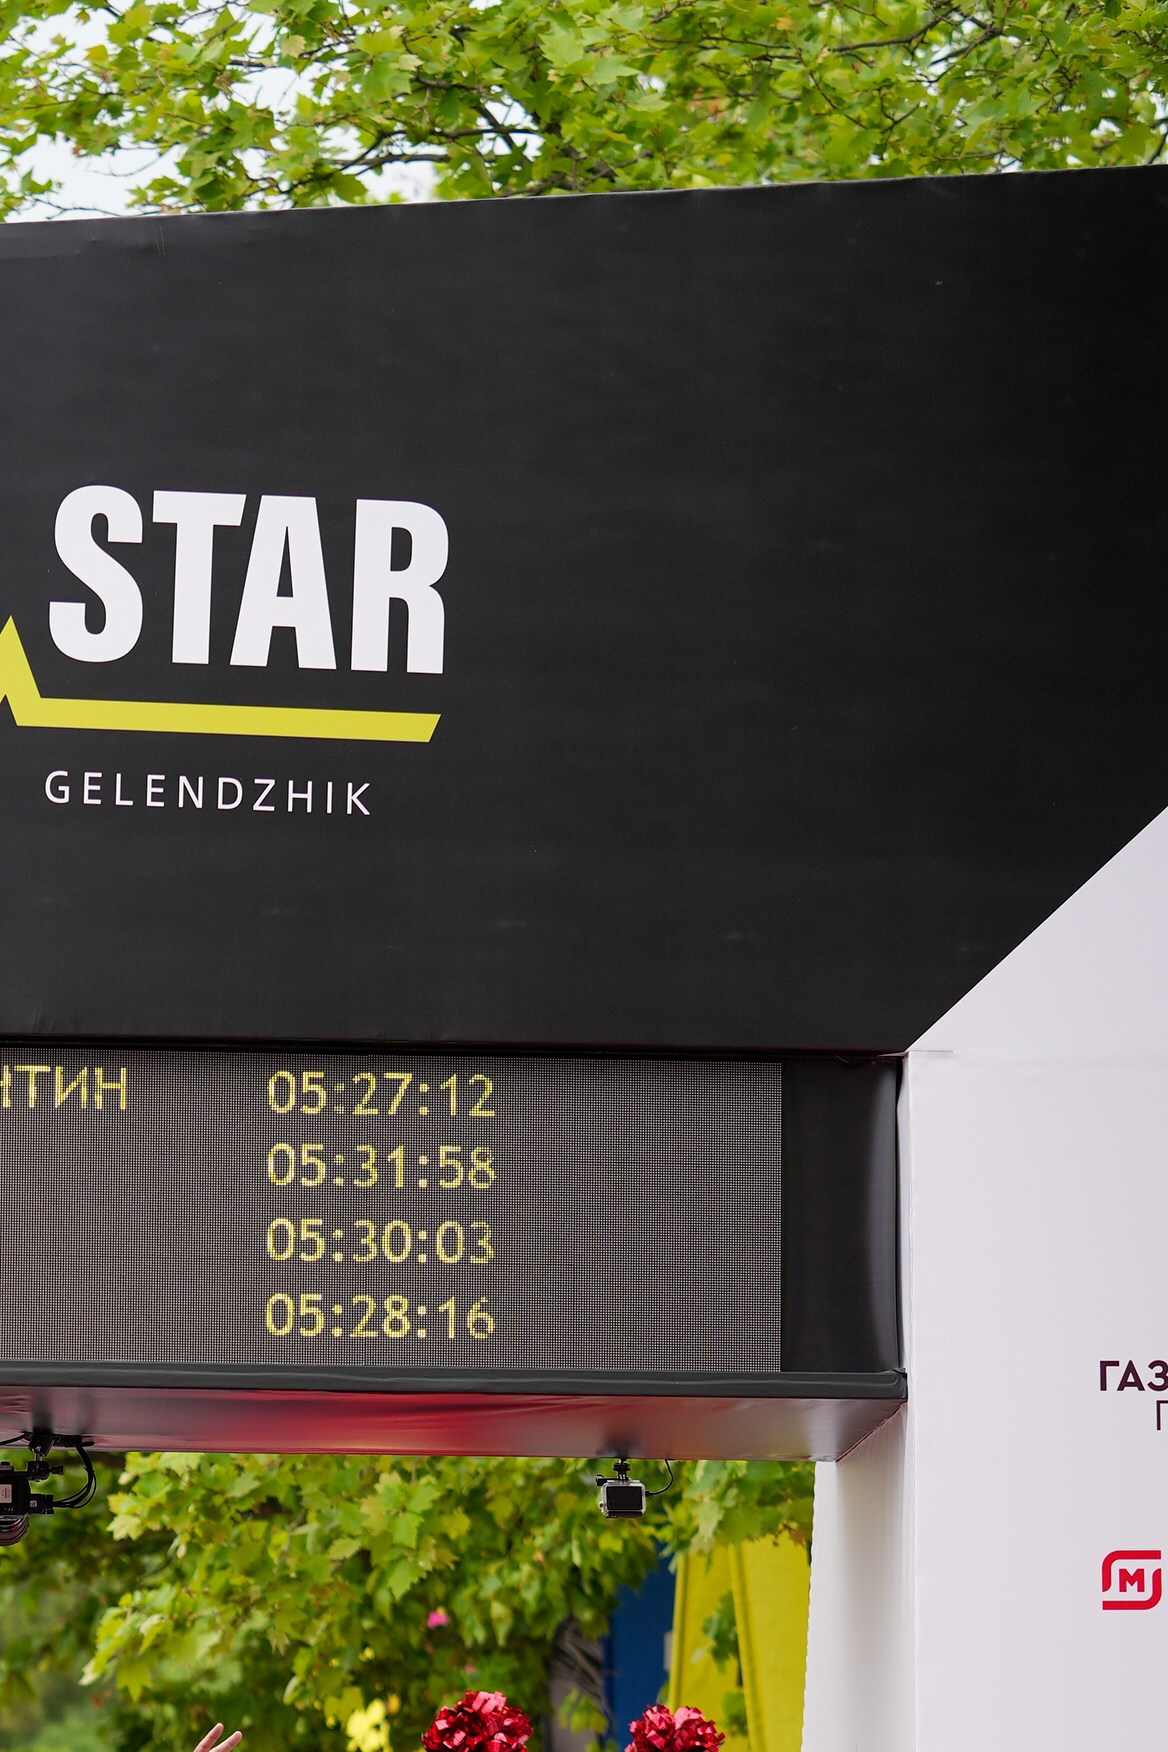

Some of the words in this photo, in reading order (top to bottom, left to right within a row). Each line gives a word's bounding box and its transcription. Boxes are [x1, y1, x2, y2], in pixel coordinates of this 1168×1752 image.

[48, 484, 451, 675] STAR
[43, 768, 373, 817] GELENDZHIK
[267, 1069, 497, 1117] 05:27:12
[266, 1142, 497, 1190] 05:31:58
[265, 1217, 496, 1266] 05:30:03
[264, 1292, 496, 1340] 05:28:16
